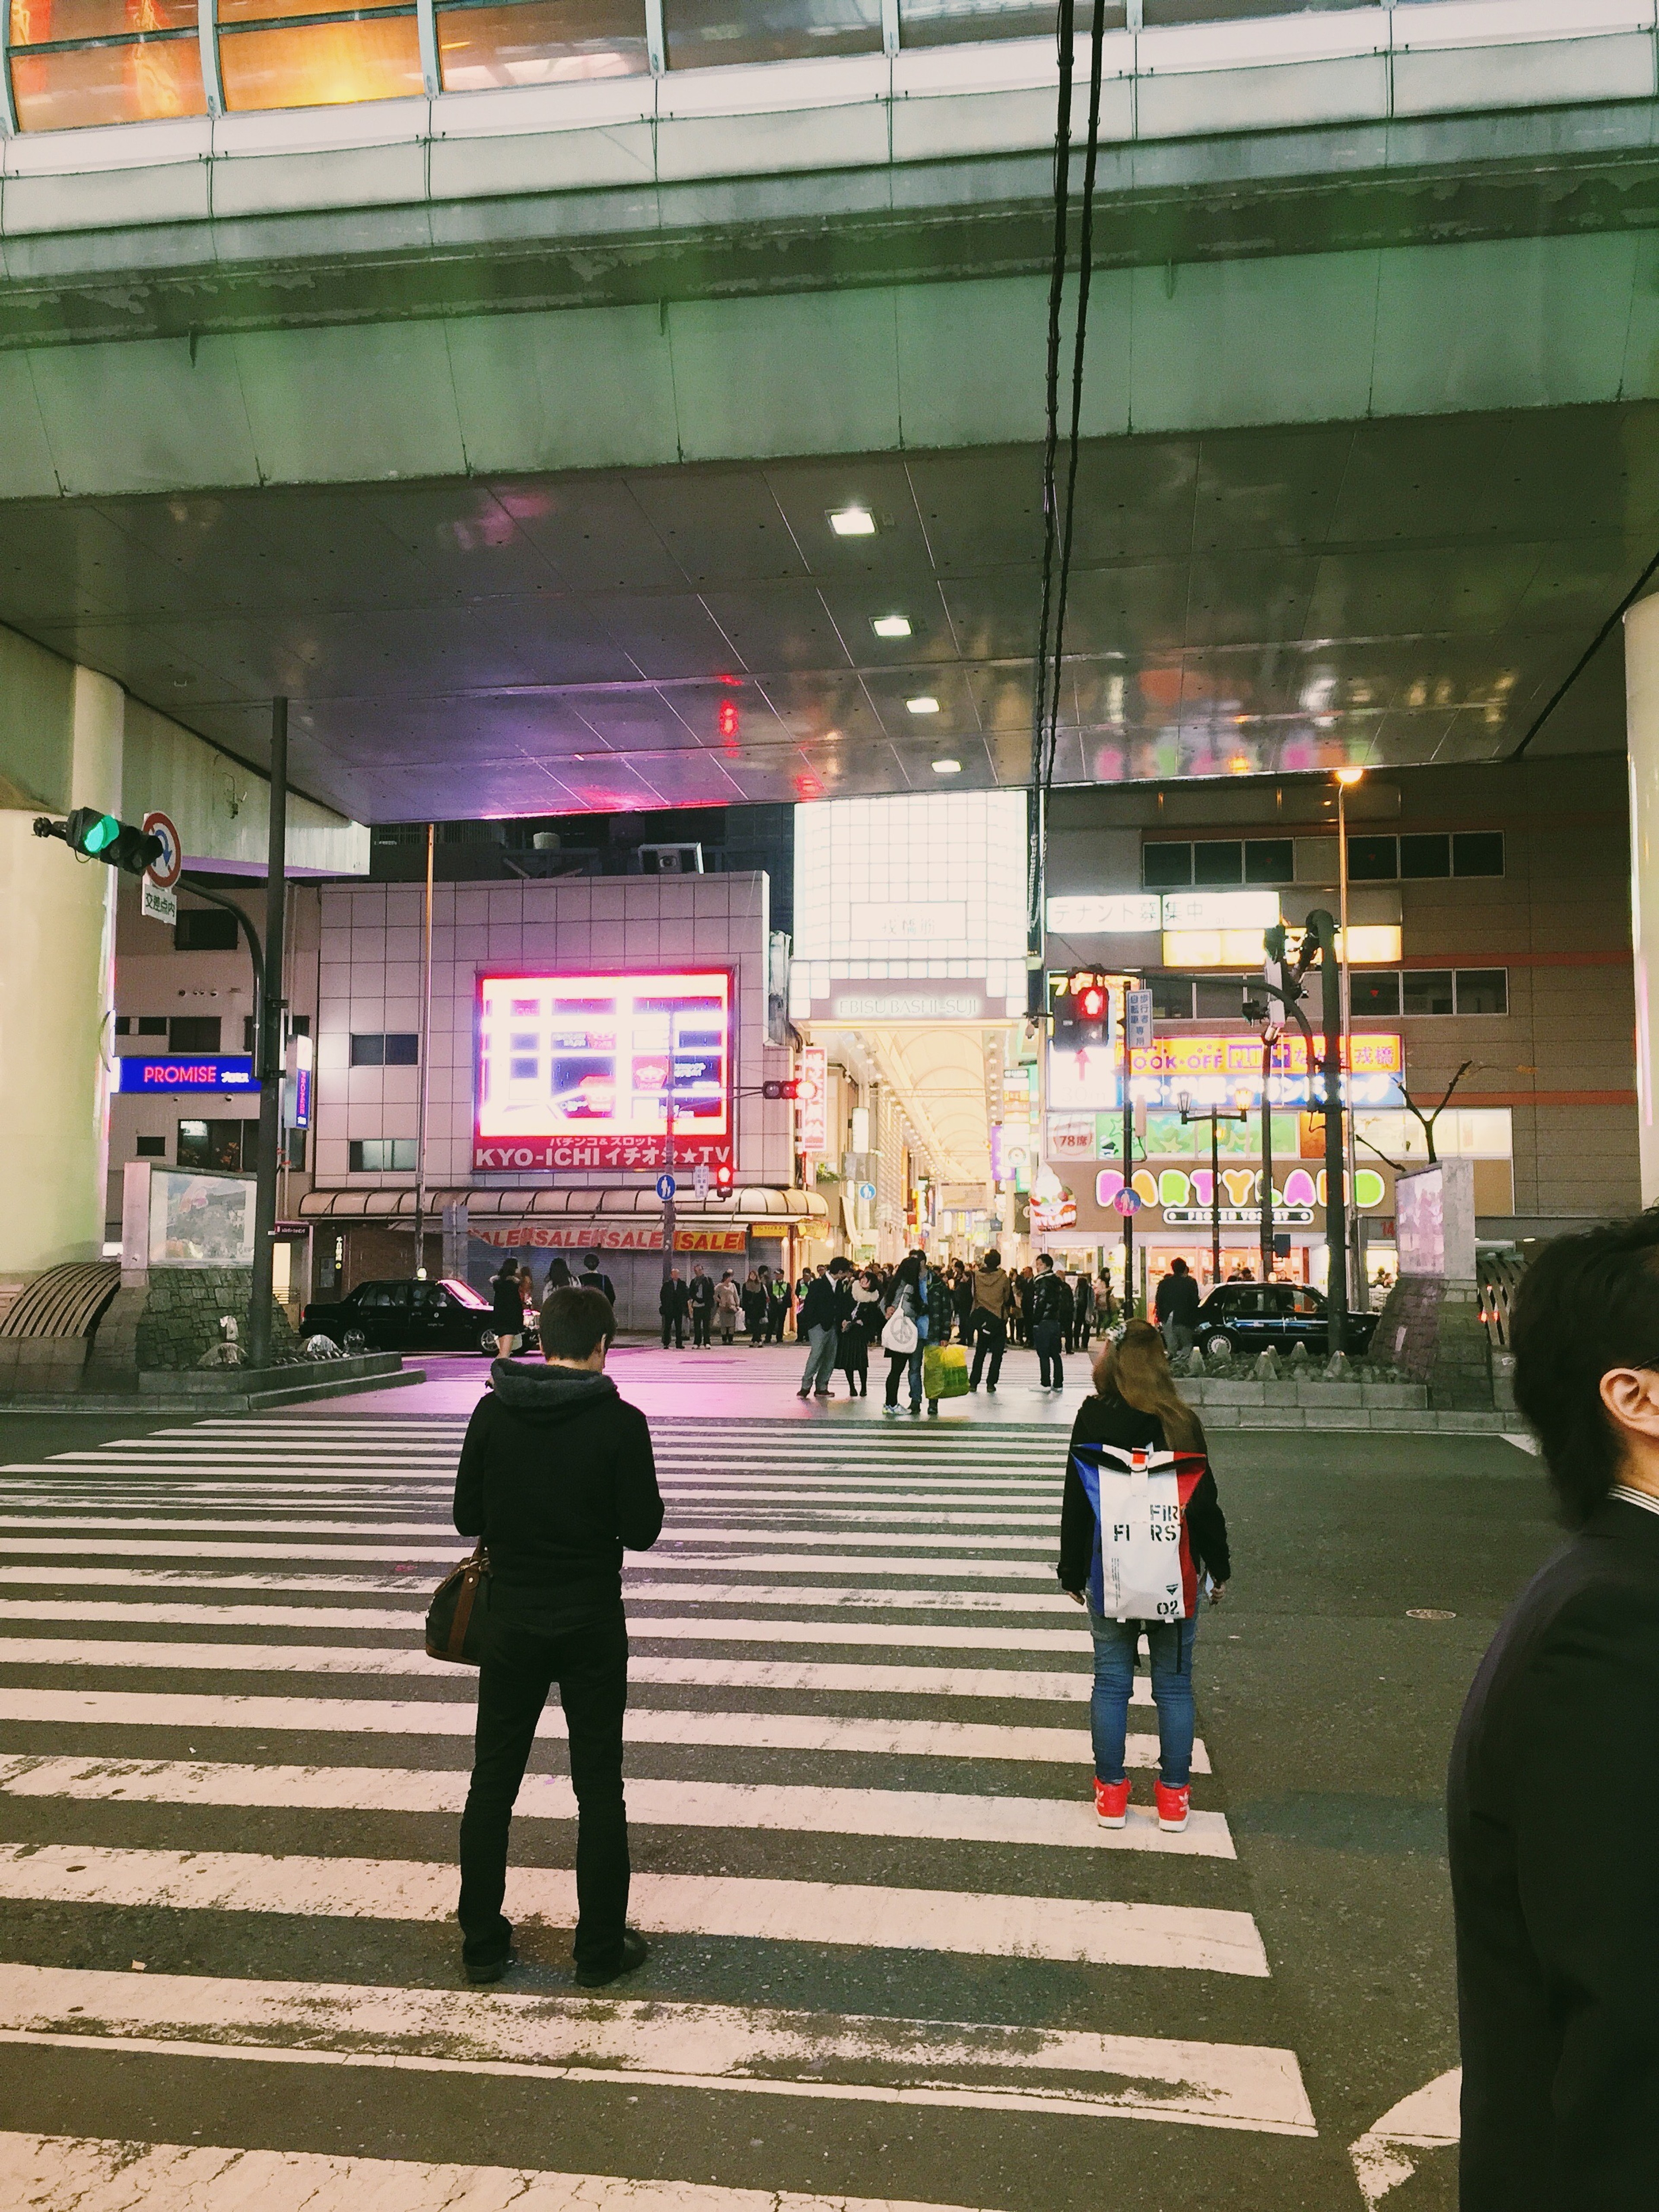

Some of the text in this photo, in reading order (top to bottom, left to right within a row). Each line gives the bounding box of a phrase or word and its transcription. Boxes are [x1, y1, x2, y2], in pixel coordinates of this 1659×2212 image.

[146, 893, 175, 918] 交差点内
[1055, 899, 1203, 924] テナント募集中
[143, 1066, 217, 1083] PROMISE
[1059, 1135, 1087, 1147] 78席
[476, 1148, 600, 1166] KYO-ICHI
[480, 1230, 521, 1247] ALE
[535, 1230, 592, 1247] SALE
[607, 1231, 664, 1248] SALE
[680, 1233, 740, 1250] SALE
[1114, 1524, 1130, 1542] FI
[1157, 1600, 1180, 1615] 02
